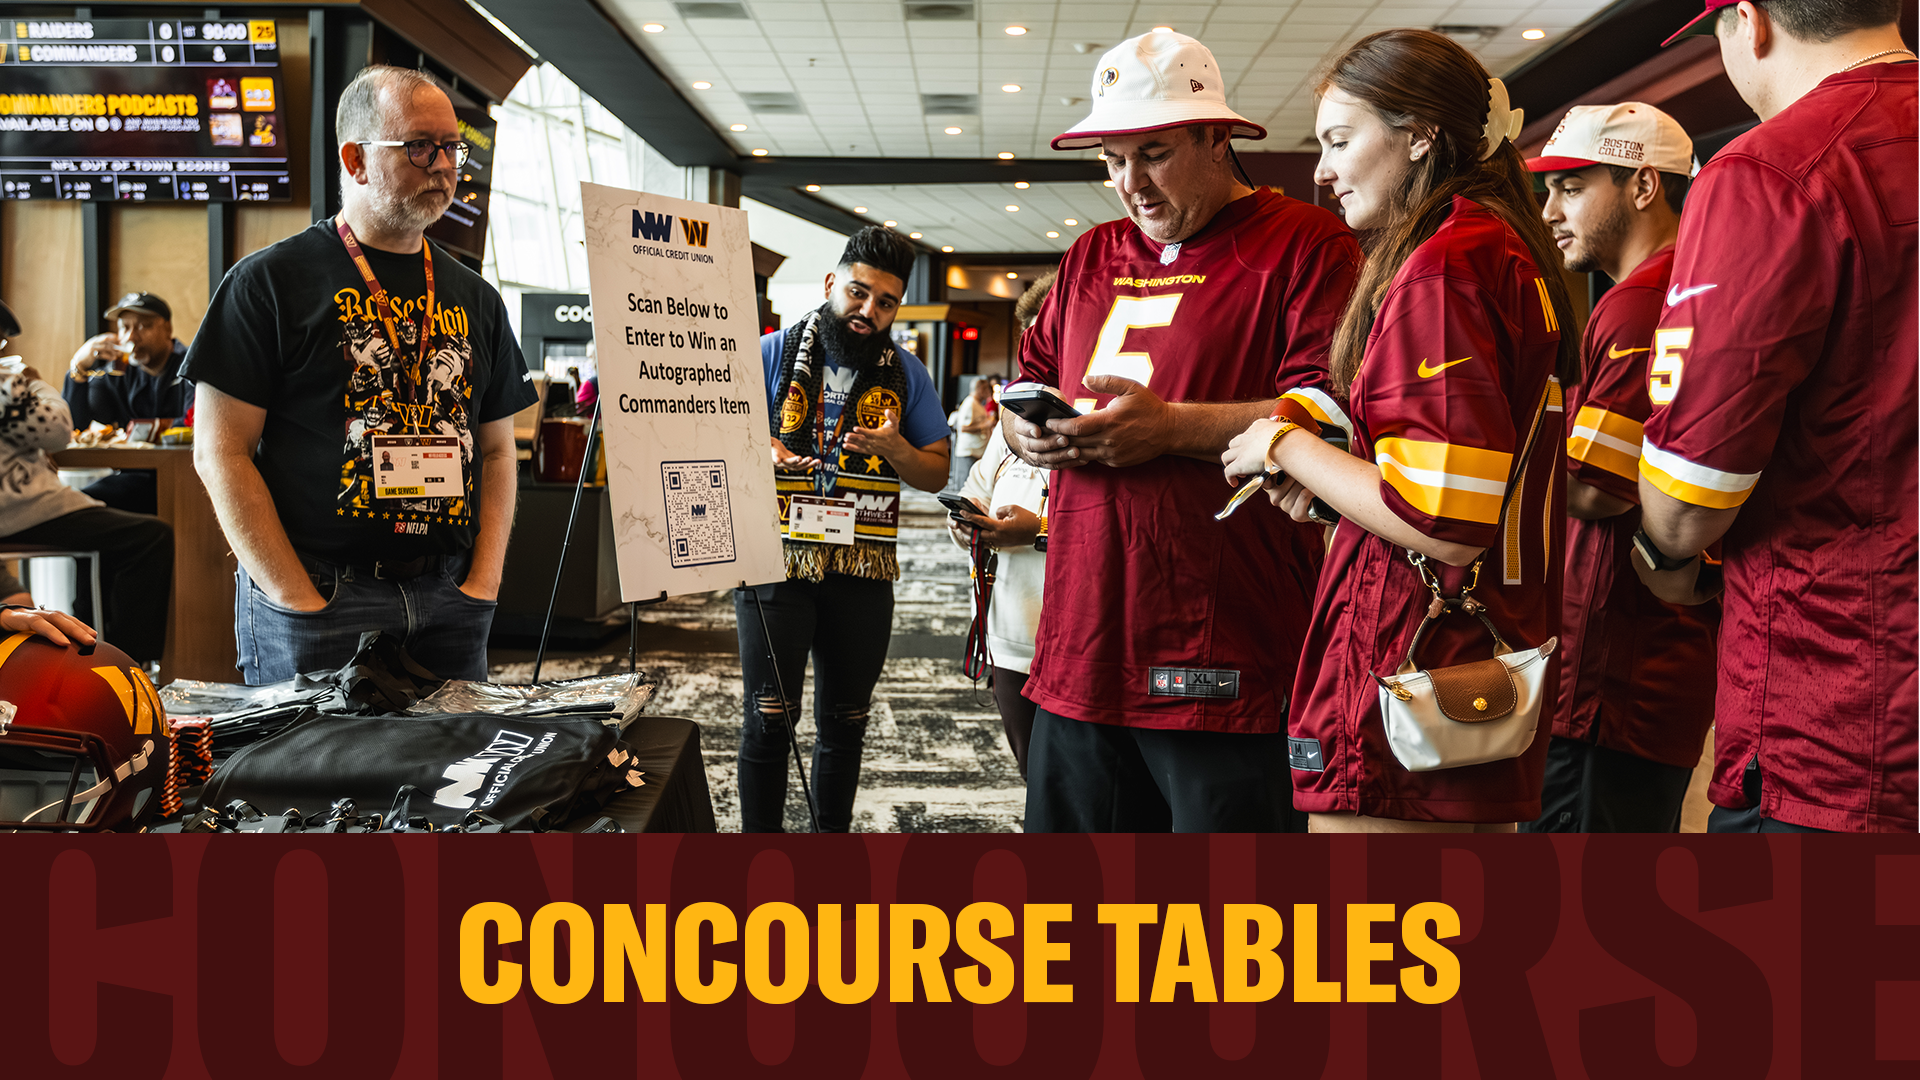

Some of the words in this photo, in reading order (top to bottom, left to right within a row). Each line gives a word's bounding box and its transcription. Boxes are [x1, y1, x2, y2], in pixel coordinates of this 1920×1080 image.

[29, 22, 94, 39] RAIDERS
[159, 23, 172, 39] 0
[202, 23, 247, 40] 90:00
[257, 26, 275, 39] 25
[31, 45, 137, 62] COMMANDERS
[162, 46, 175, 62] 0
[0, 94, 107, 116] OMMANDERS
[108, 94, 199, 116] PODCASTS
[70, 118, 95, 131] ON
[1603, 138, 1644, 152] BOSTON
[1598, 146, 1645, 161] COLLEGE
[51, 160, 78, 171] NFL
[80, 160, 108, 171] OUT
[111, 160, 130, 171] OF
[133, 160, 173, 172] TOWN
[176, 160, 230, 172] SCORES
[631, 208, 673, 243] NW
[632, 244, 665, 258] OFFICIAL
[665, 249, 690, 261] CREDIT
[690, 252, 714, 264] UNION
[1112, 274, 1206, 288] WASHINGTON
[627, 292, 663, 315] Scan
[666, 296, 710, 318] Below
[713, 303, 729, 320] to
[625, 326, 665, 347] Enter
[668, 331, 685, 349] to
[687, 330, 717, 350] Win
[720, 337, 737, 351] an
[638, 360, 731, 386] Autographed
[1648, 327, 1694, 406] 5
[618, 393, 717, 415] Commanders
[719, 396, 750, 415] Item
[384, 487, 397, 496] GAME
[397, 486, 419, 495] SERVICES
[854, 510, 894, 519] RTHWEST
[405, 521, 429, 535] NFLPA
[1193, 673, 1212, 684] XL
[531, 731, 558, 755] UNION
[1294, 743, 1303, 755] M
